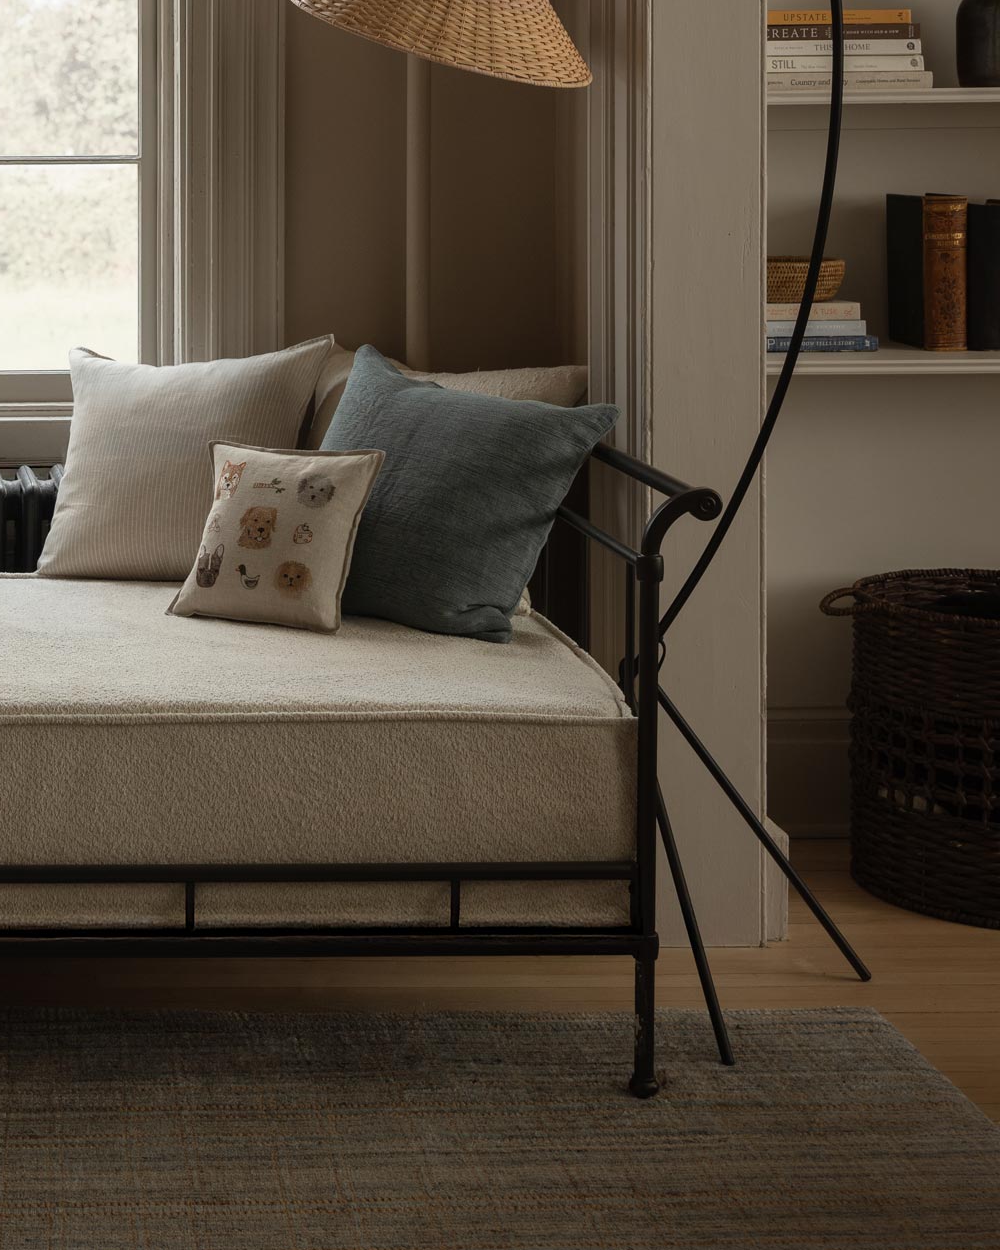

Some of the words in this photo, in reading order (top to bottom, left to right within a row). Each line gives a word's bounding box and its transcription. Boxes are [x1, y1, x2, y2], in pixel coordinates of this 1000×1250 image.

[783, 13, 827, 22] UPSTATE
[844, 43, 871, 51] HOME
[771, 59, 797, 69] STILL
